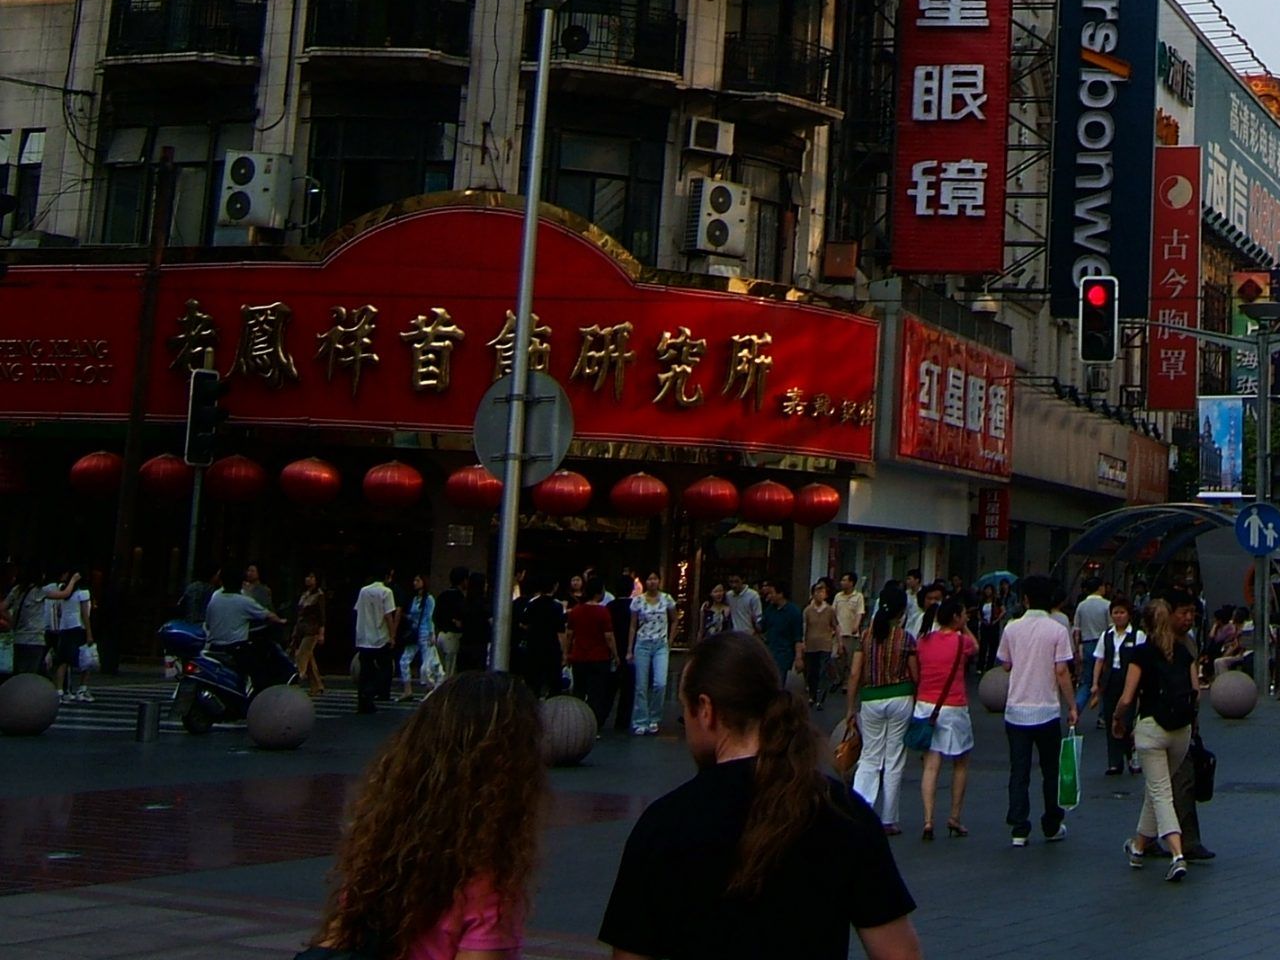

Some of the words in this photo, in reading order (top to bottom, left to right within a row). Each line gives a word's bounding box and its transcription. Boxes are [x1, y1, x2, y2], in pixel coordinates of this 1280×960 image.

[1157, 228, 1193, 380] 古今胸罩
[916, 360, 1007, 440] 红星眼镜
